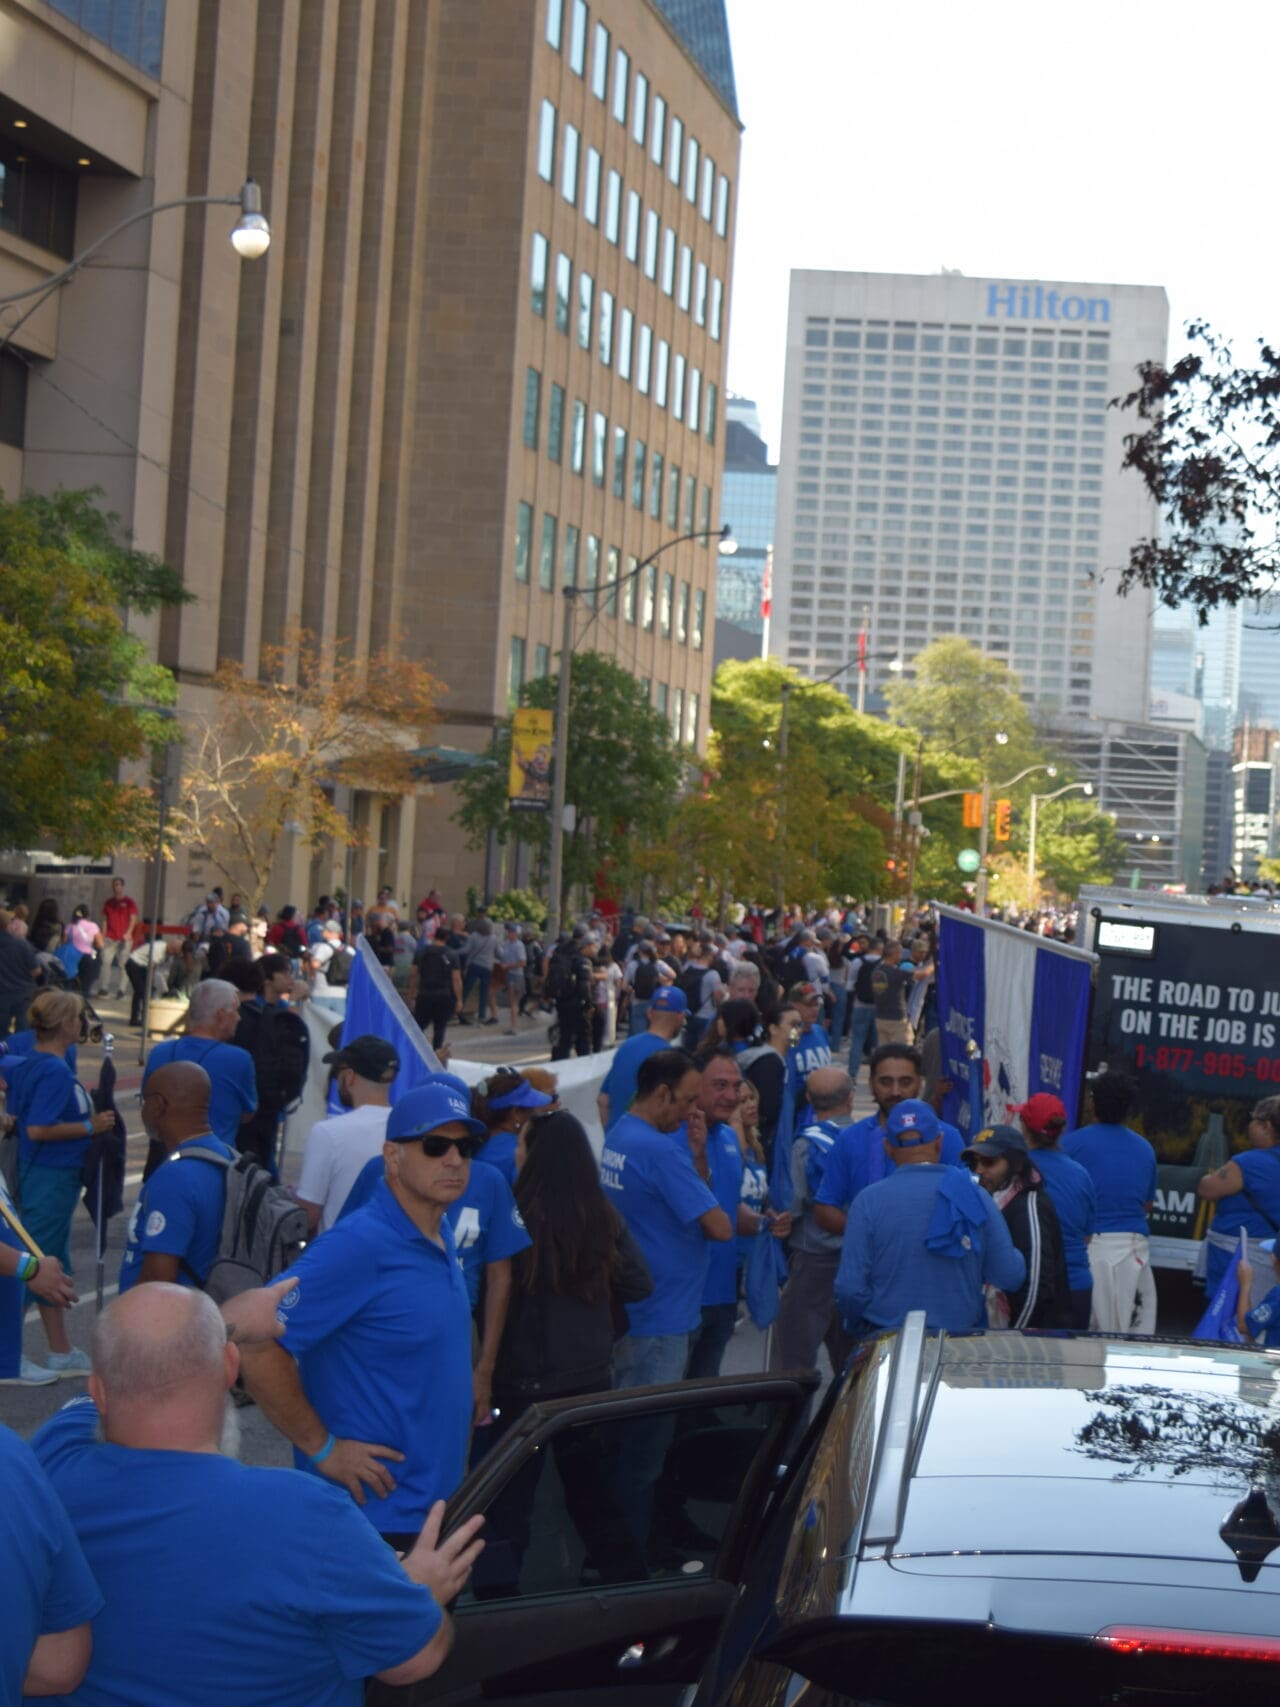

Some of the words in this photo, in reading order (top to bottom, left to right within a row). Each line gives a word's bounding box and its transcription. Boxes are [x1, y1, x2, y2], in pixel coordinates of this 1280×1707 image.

[986, 284, 1111, 323] Hilton
[1112, 974, 1153, 1002] THE
[1158, 979, 1221, 1010] ROAD
[1228, 986, 1255, 1013] TO
[1120, 1008, 1152, 1036] ON
[1158, 1011, 1200, 1041] THE
[1204, 1016, 1247, 1046] JOB
[1253, 1022, 1276, 1049] IS
[1151, 1188, 1196, 1214] AM
